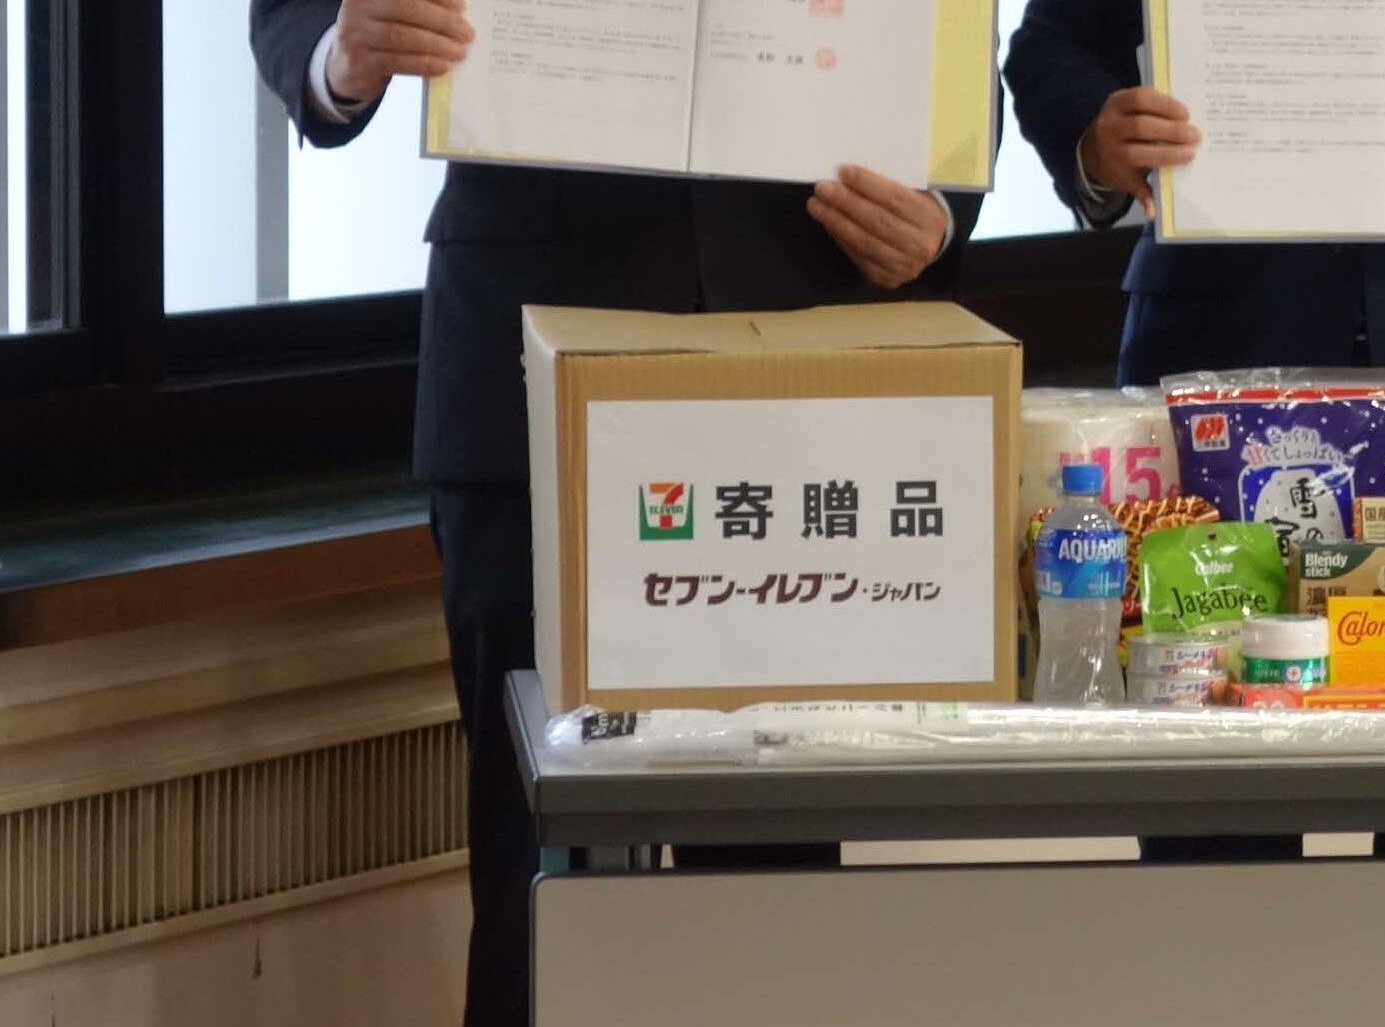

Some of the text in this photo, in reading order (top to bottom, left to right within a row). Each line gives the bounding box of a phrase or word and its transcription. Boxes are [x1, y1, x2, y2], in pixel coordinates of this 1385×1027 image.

[714, 479, 944, 541] 寄贈品
[1304, 552, 1349, 571] Blendy
[1304, 567, 1332, 578] stick
[1171, 586, 1269, 620] Jagabee
